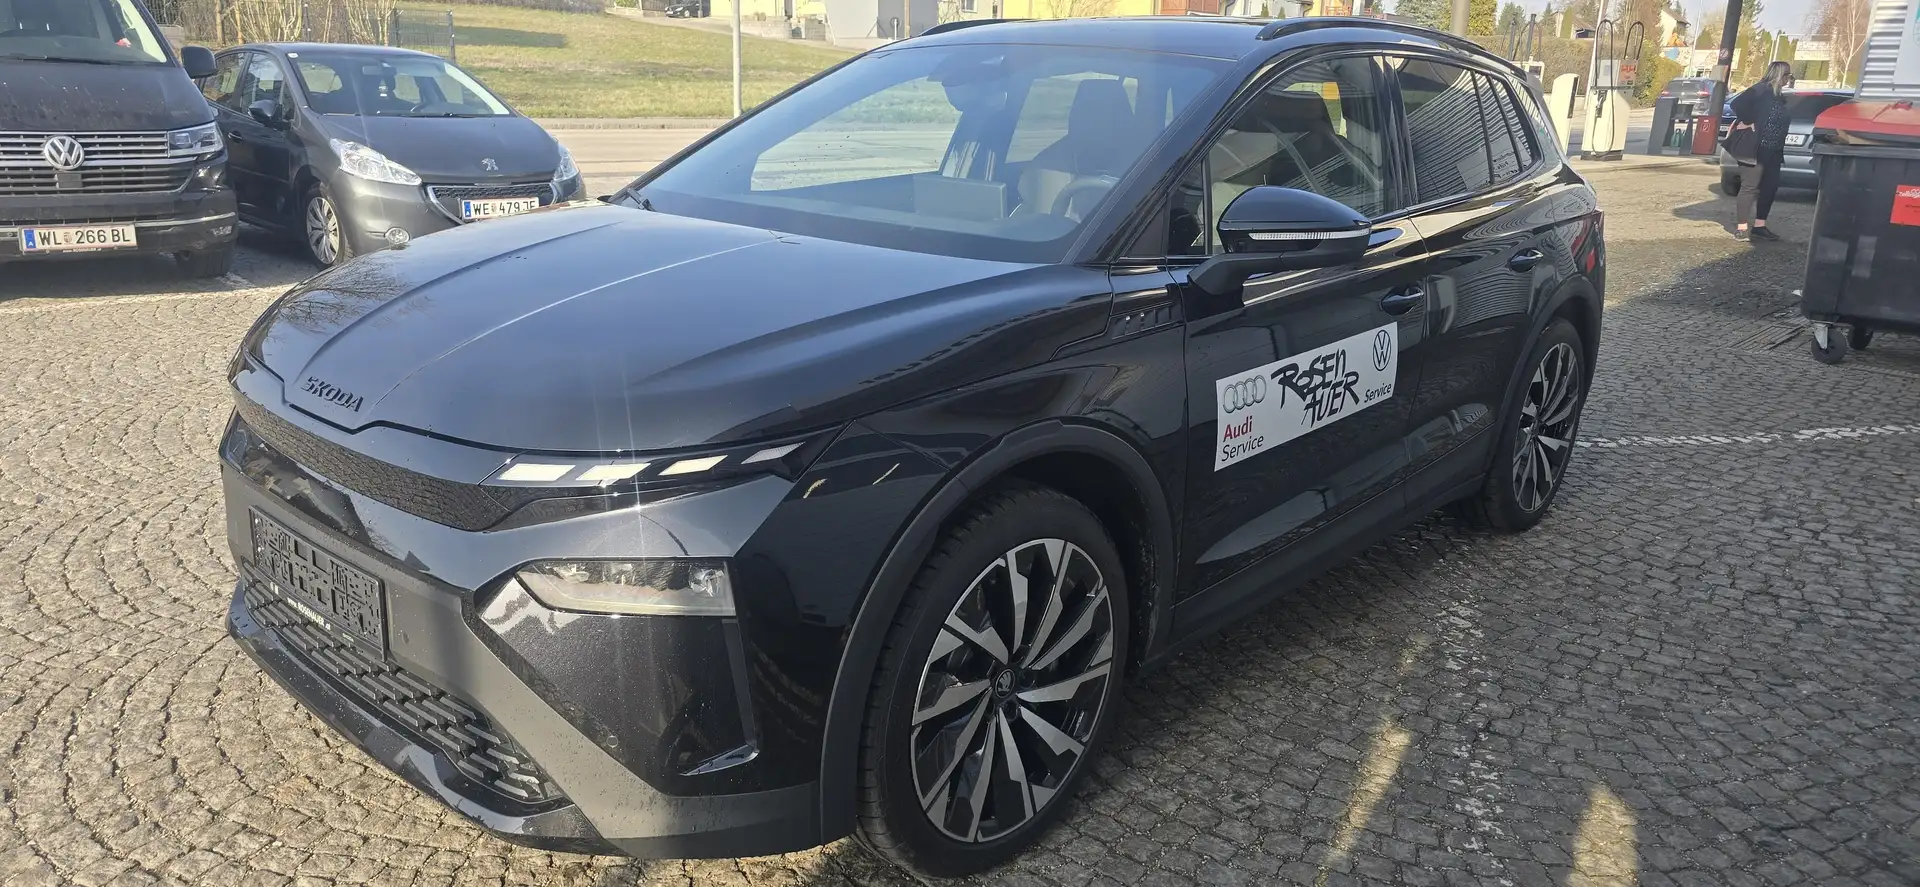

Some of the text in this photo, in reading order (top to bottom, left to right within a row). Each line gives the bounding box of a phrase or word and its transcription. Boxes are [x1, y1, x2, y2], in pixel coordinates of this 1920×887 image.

[473, 203, 490, 215] WE
[500, 202, 520, 214] 479
[39, 231, 62, 246] WL
[75, 229, 107, 244] 266
[111, 228, 131, 243] BL
[1364, 383, 1392, 403] Service
[1223, 415, 1253, 442] Audi
[1221, 433, 1264, 462] Service
